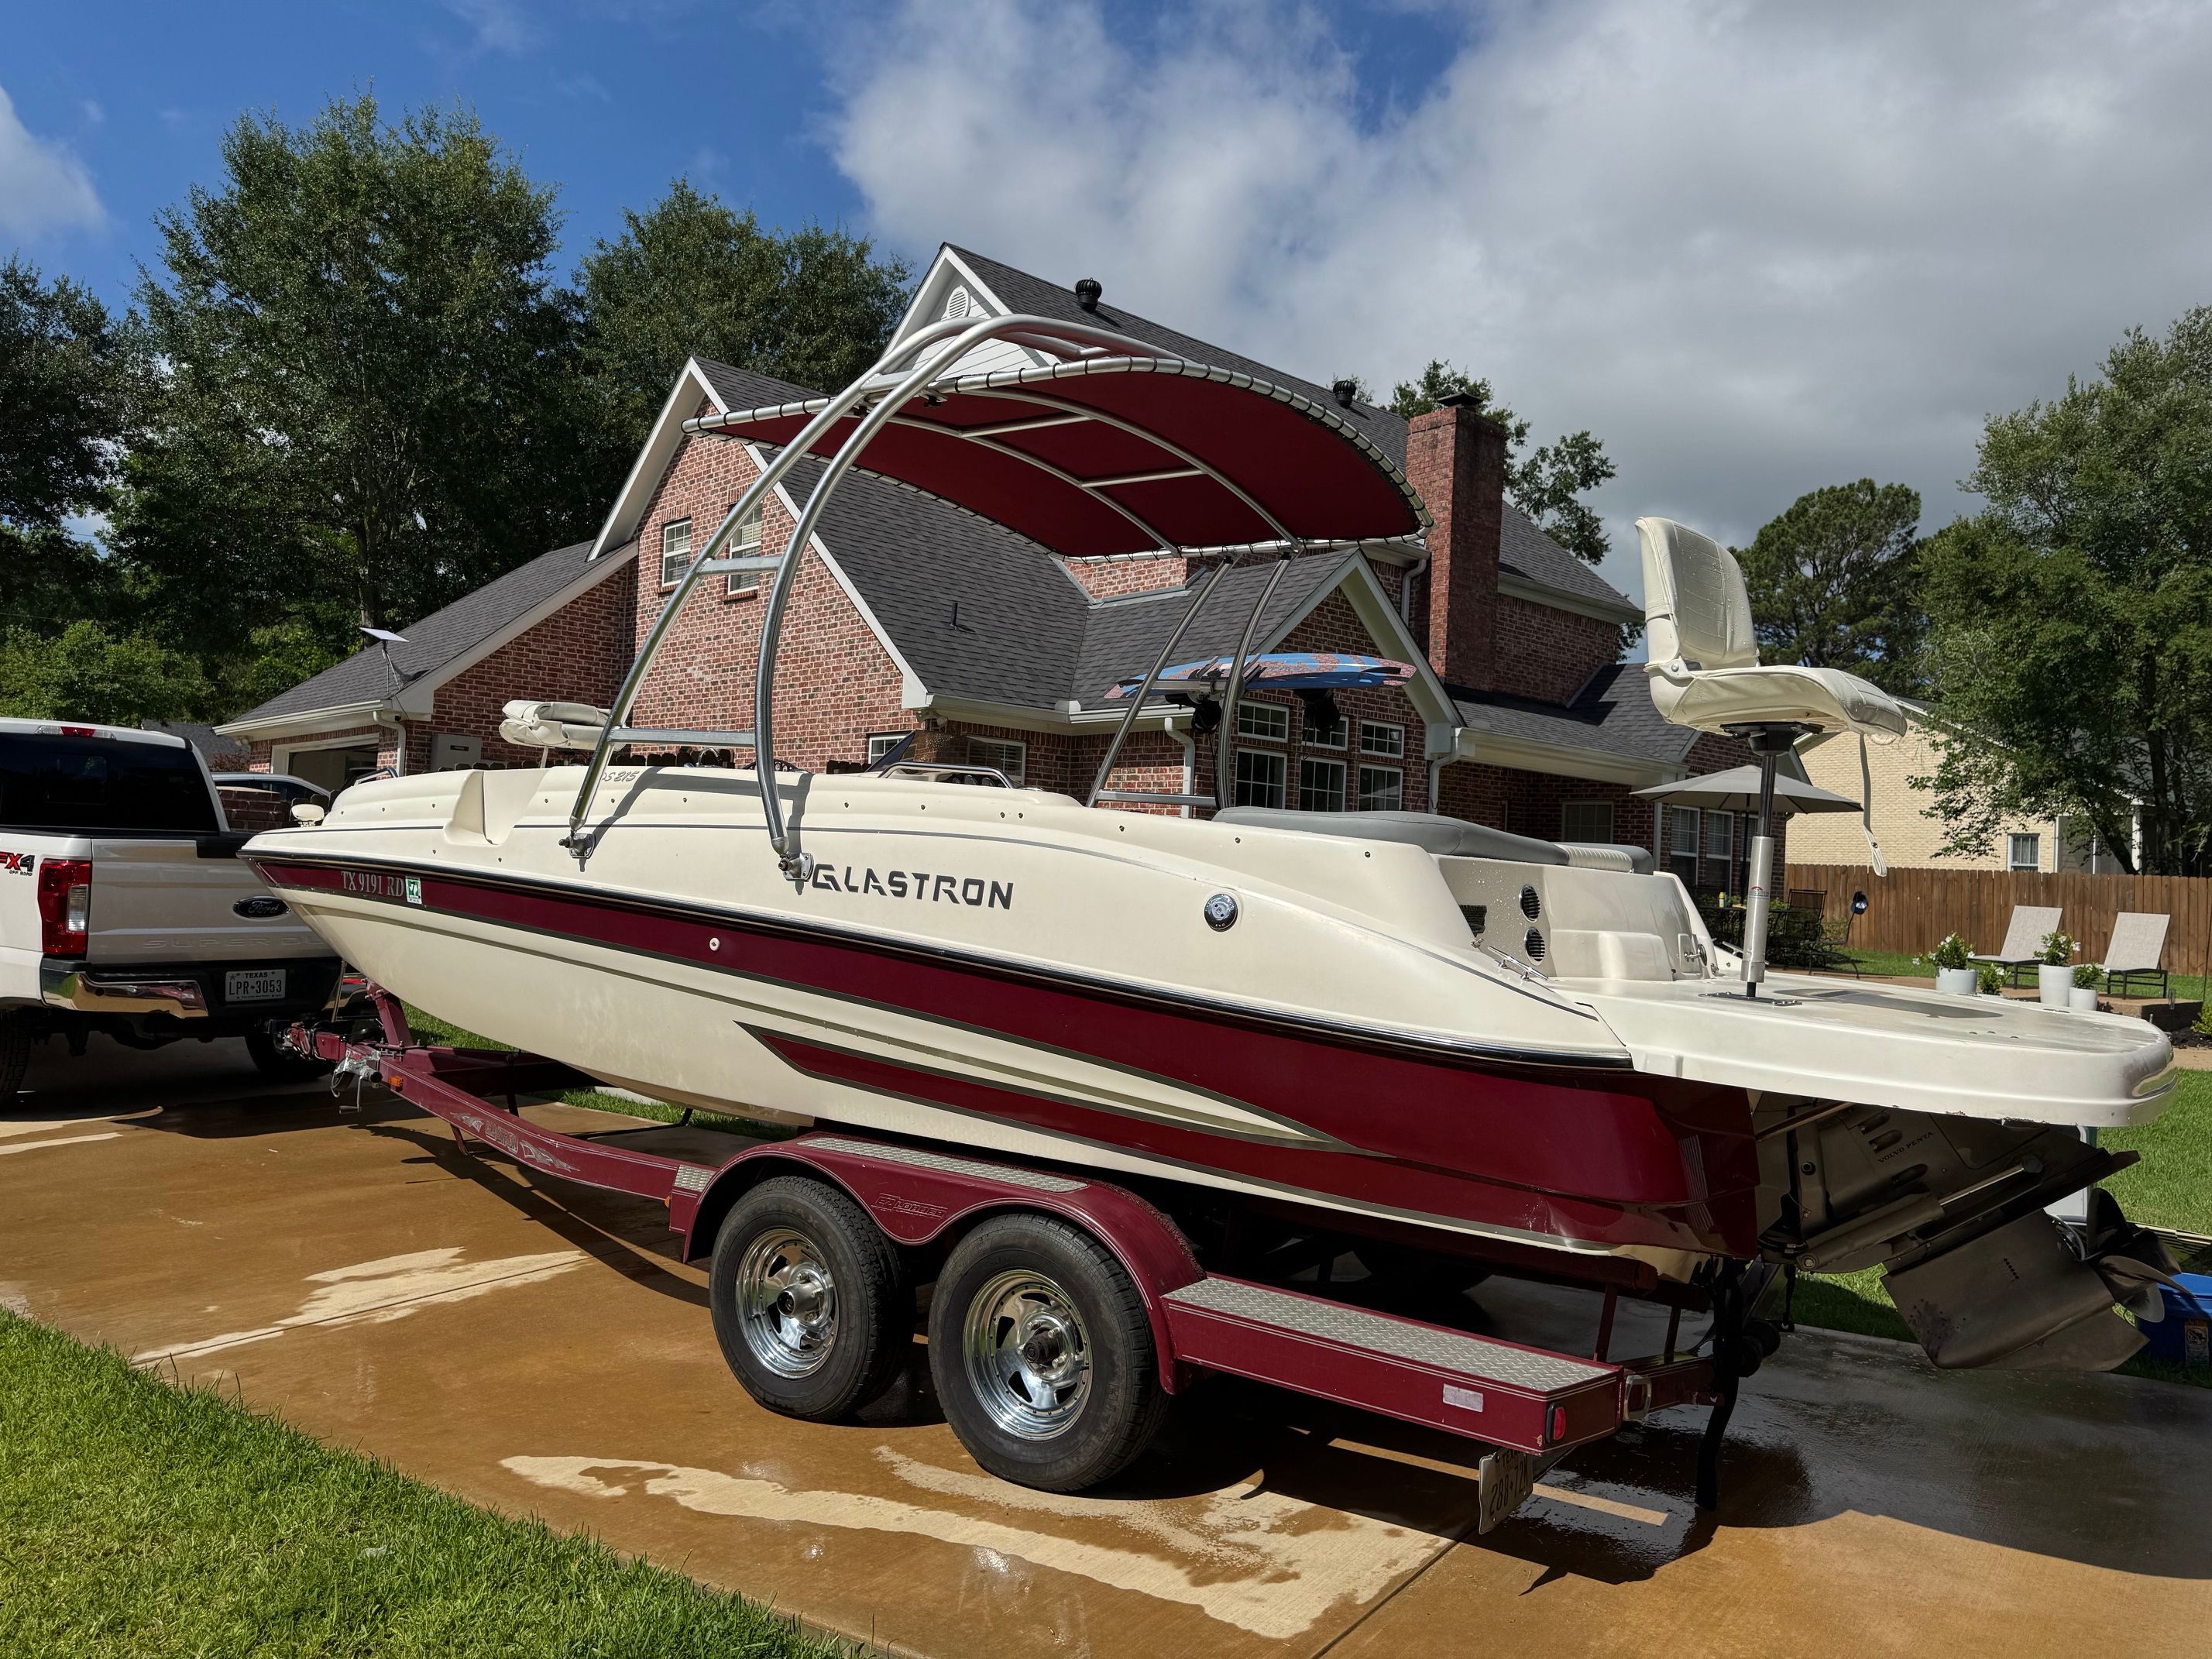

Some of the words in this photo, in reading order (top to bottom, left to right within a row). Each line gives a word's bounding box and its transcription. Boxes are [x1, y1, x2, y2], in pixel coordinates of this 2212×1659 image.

[341, 871, 357, 891] TX
[358, 873, 383, 895] 9191
[386, 877, 404, 897] RD
[811, 863, 1015, 911] GLASTRON
[248, 900, 280, 914] Ford
[143, 936, 272, 949] SUPER
[280, 935, 325, 946] DU
[1877, 1146, 1905, 1163] VOLVO
[1905, 1132, 1934, 1149] PENTA
[893, 1200, 947, 1218] LOADER
